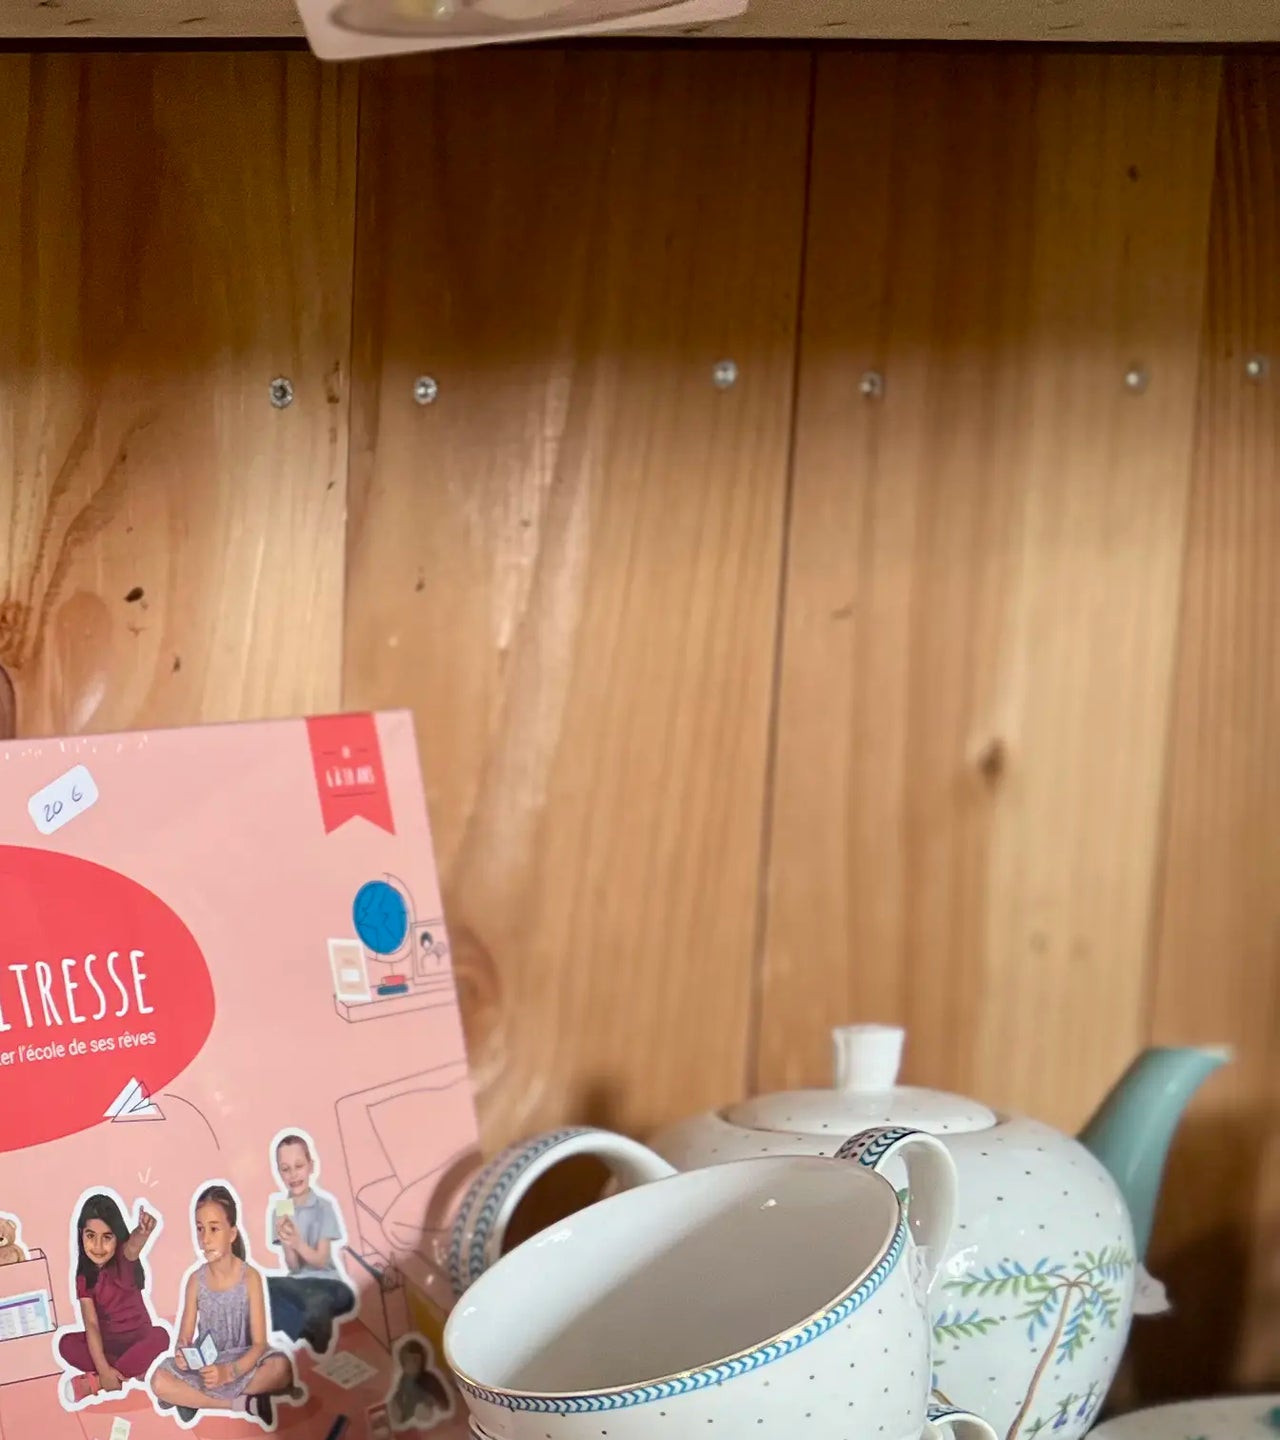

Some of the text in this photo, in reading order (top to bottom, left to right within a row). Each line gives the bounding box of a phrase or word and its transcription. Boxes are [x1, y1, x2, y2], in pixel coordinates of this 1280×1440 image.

[43, 800, 64, 823] 20
[18, 1042, 66, 1066] l'école
[68, 1040, 88, 1060] de
[90, 1039, 115, 1058] ses
[117, 1029, 157, 1055] rêves
